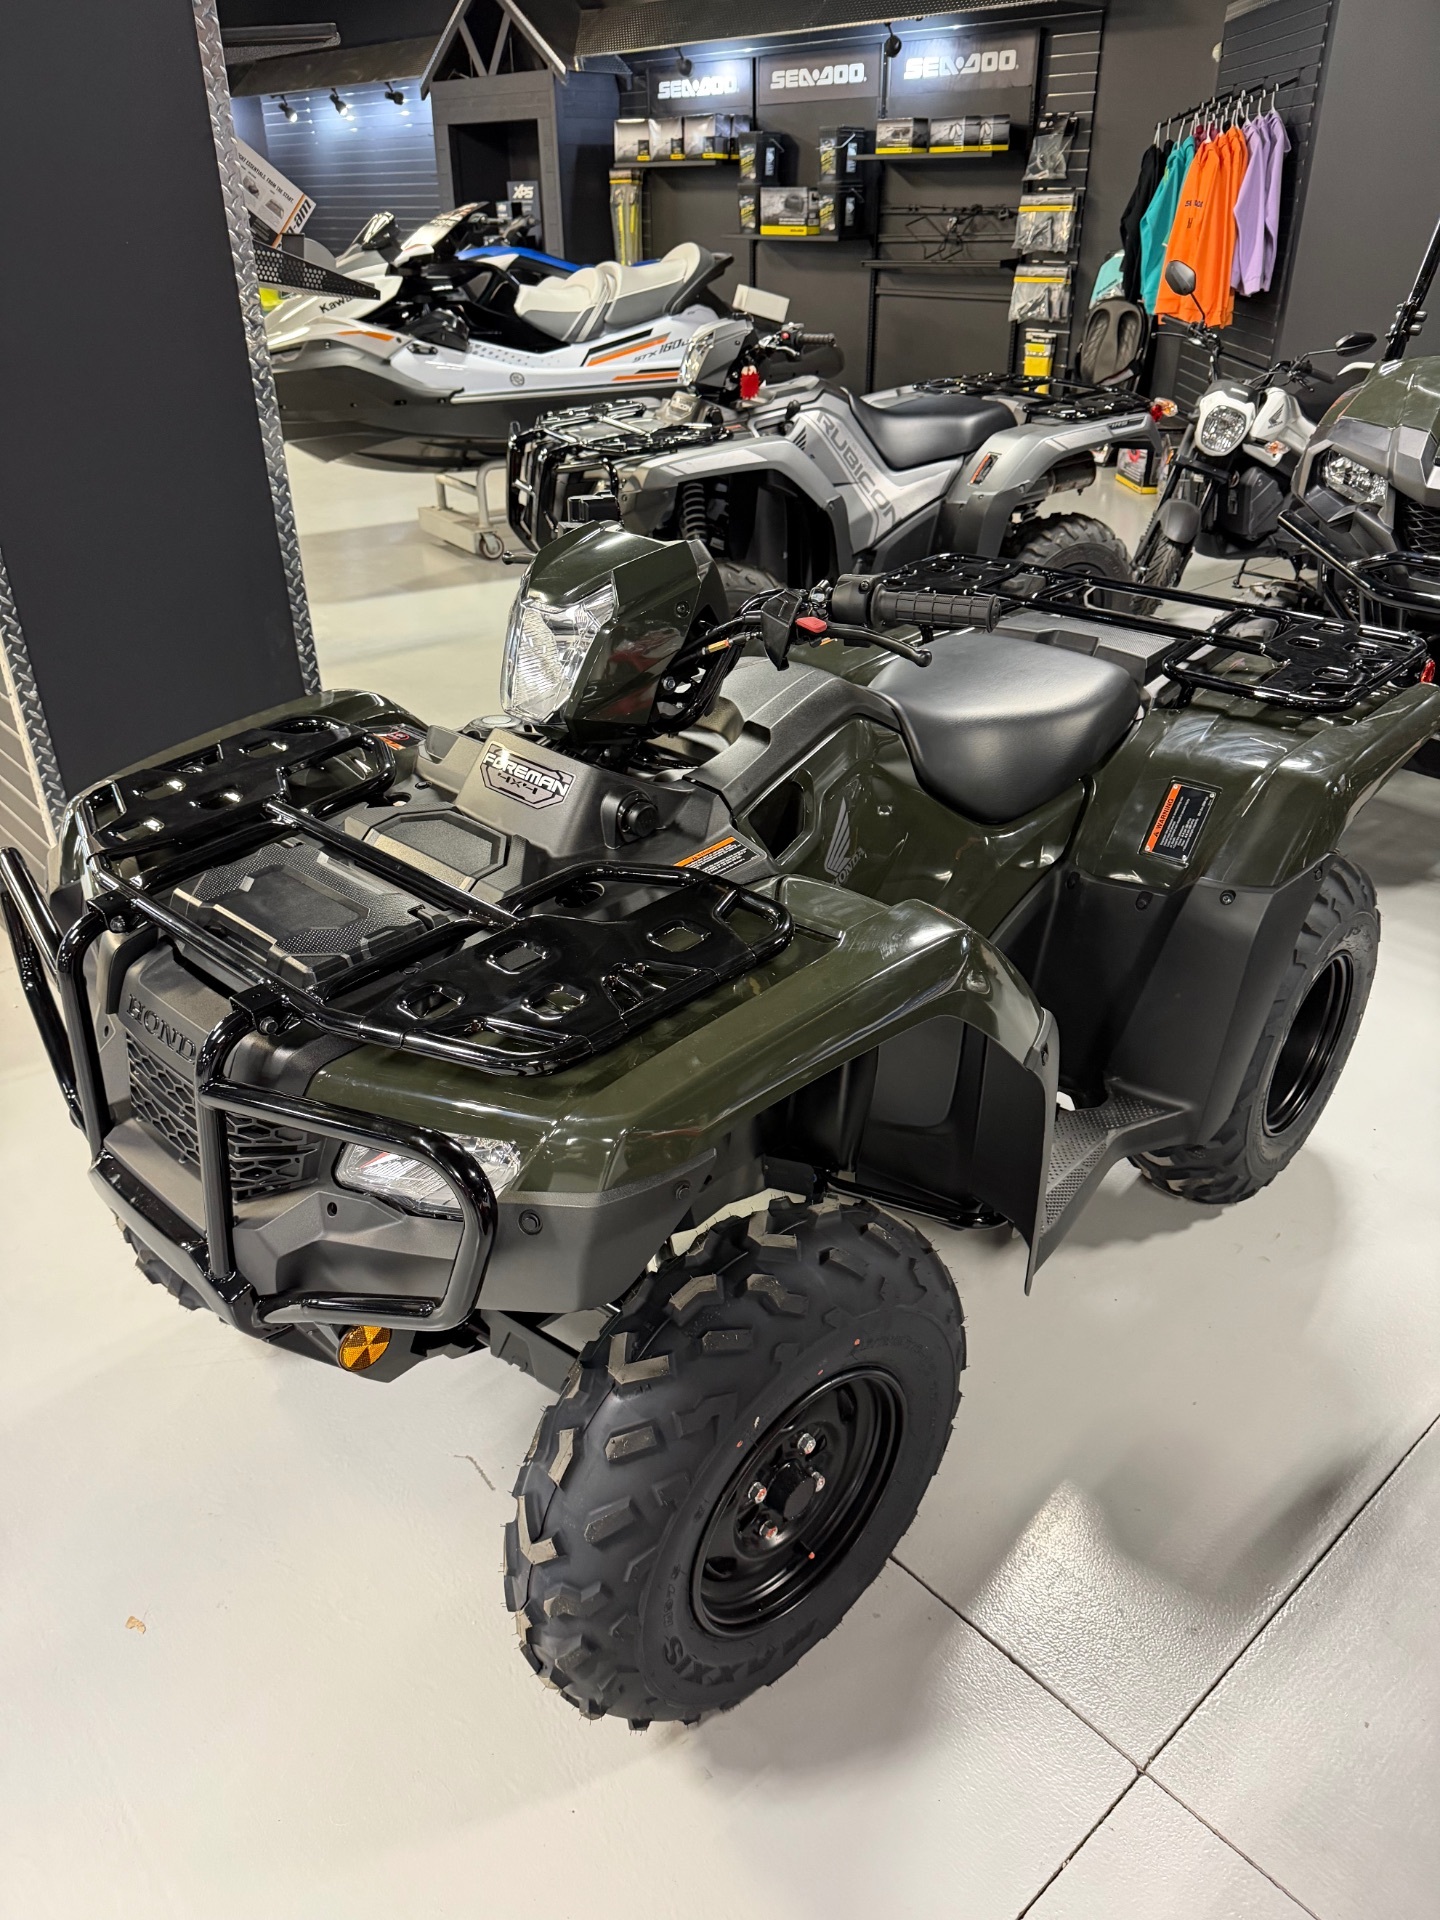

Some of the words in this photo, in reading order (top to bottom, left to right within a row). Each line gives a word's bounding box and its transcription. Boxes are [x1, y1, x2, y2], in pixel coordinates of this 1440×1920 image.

[512, 184, 534, 199] XPS
[483, 752, 570, 796] FOREMAN
[1156, 798, 1174, 831] WARNING
[127, 994, 197, 1066] HOND
